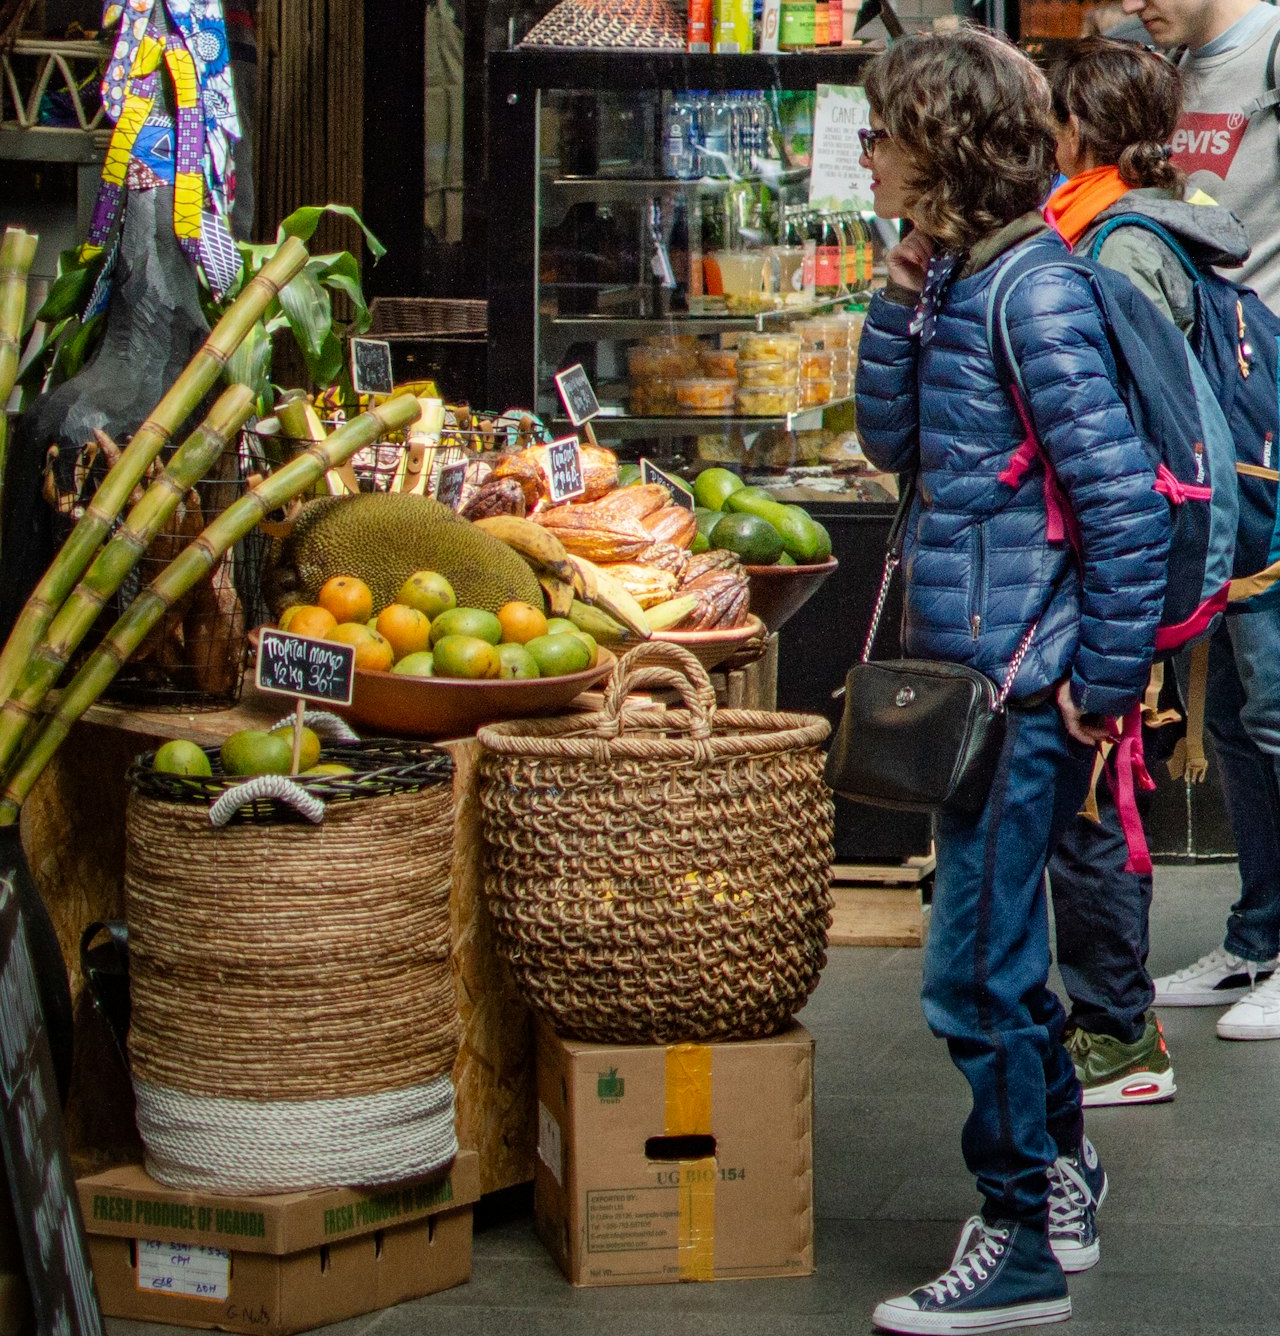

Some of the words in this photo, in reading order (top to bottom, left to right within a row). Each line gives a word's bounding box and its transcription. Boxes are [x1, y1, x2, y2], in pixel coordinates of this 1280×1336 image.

[657, 1172, 679, 1185] UG
[720, 1167, 746, 1182] 154
[93, 1194, 133, 1223] FRESH
[136, 1199, 194, 1230] PRODUCE
[198, 1206, 213, 1232] OF
[215, 1207, 266, 1238] UGANDA
